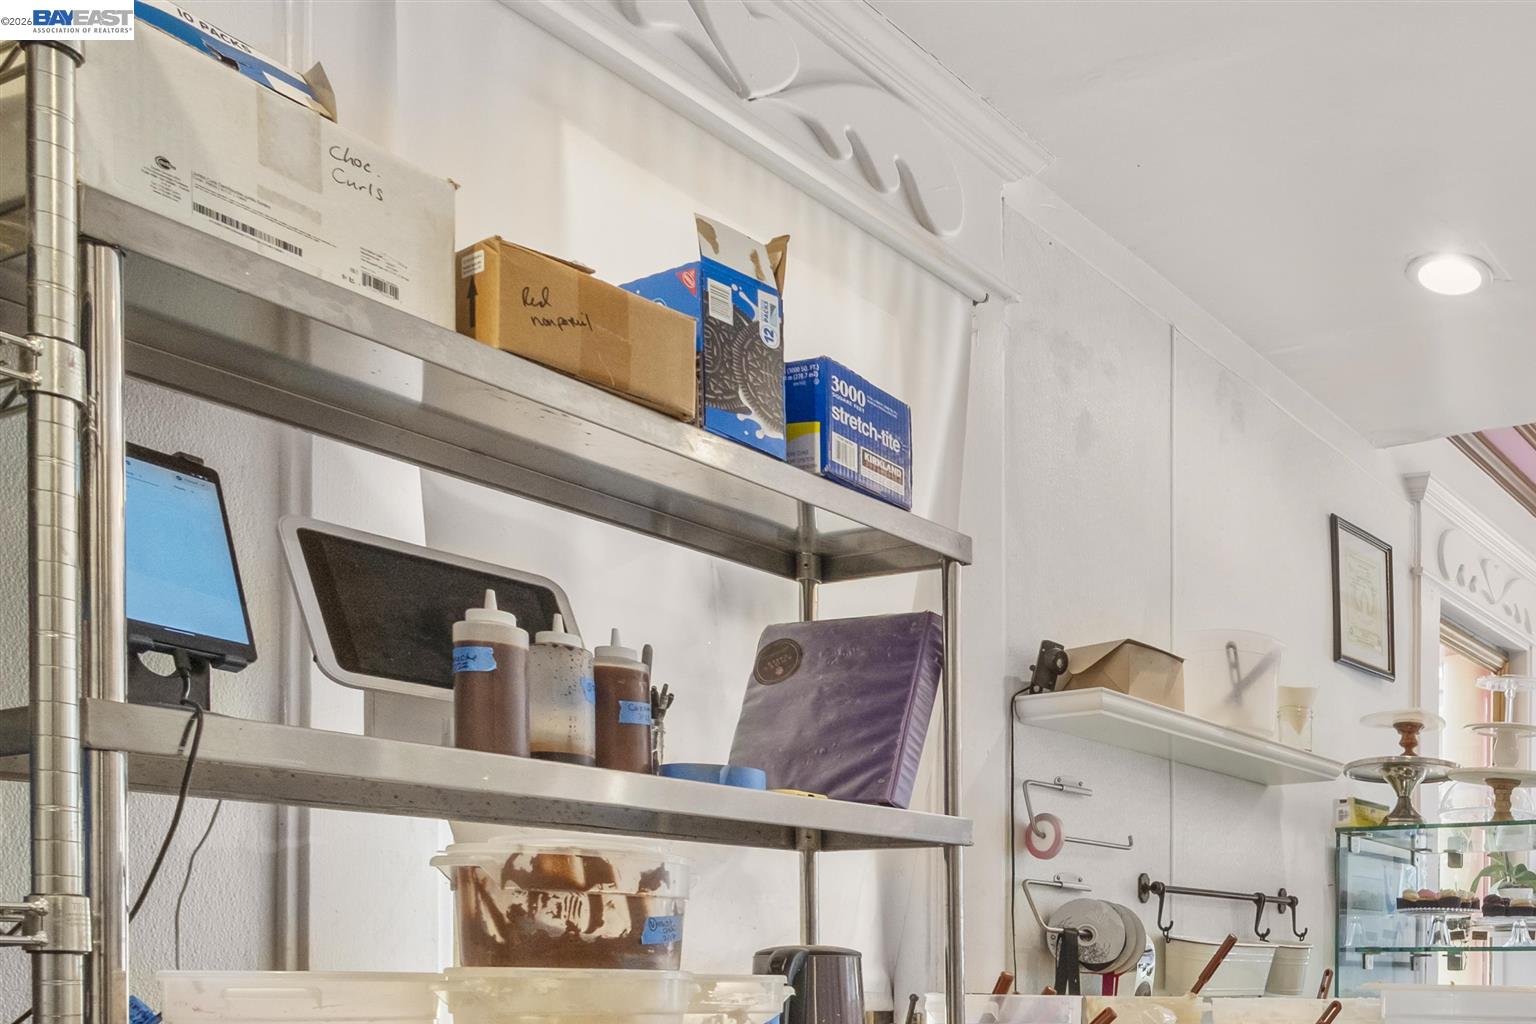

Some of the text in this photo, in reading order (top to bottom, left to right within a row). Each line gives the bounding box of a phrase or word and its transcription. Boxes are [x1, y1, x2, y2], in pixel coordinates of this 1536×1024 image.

[177, 8, 252, 54] 10 PACKS
[332, 161, 384, 201] Curls
[763, 327, 775, 344] 12
[831, 375, 866, 407] 3000
[831, 405, 901, 453] stretch-tite
[864, 451, 902, 476] KIRKLAND
